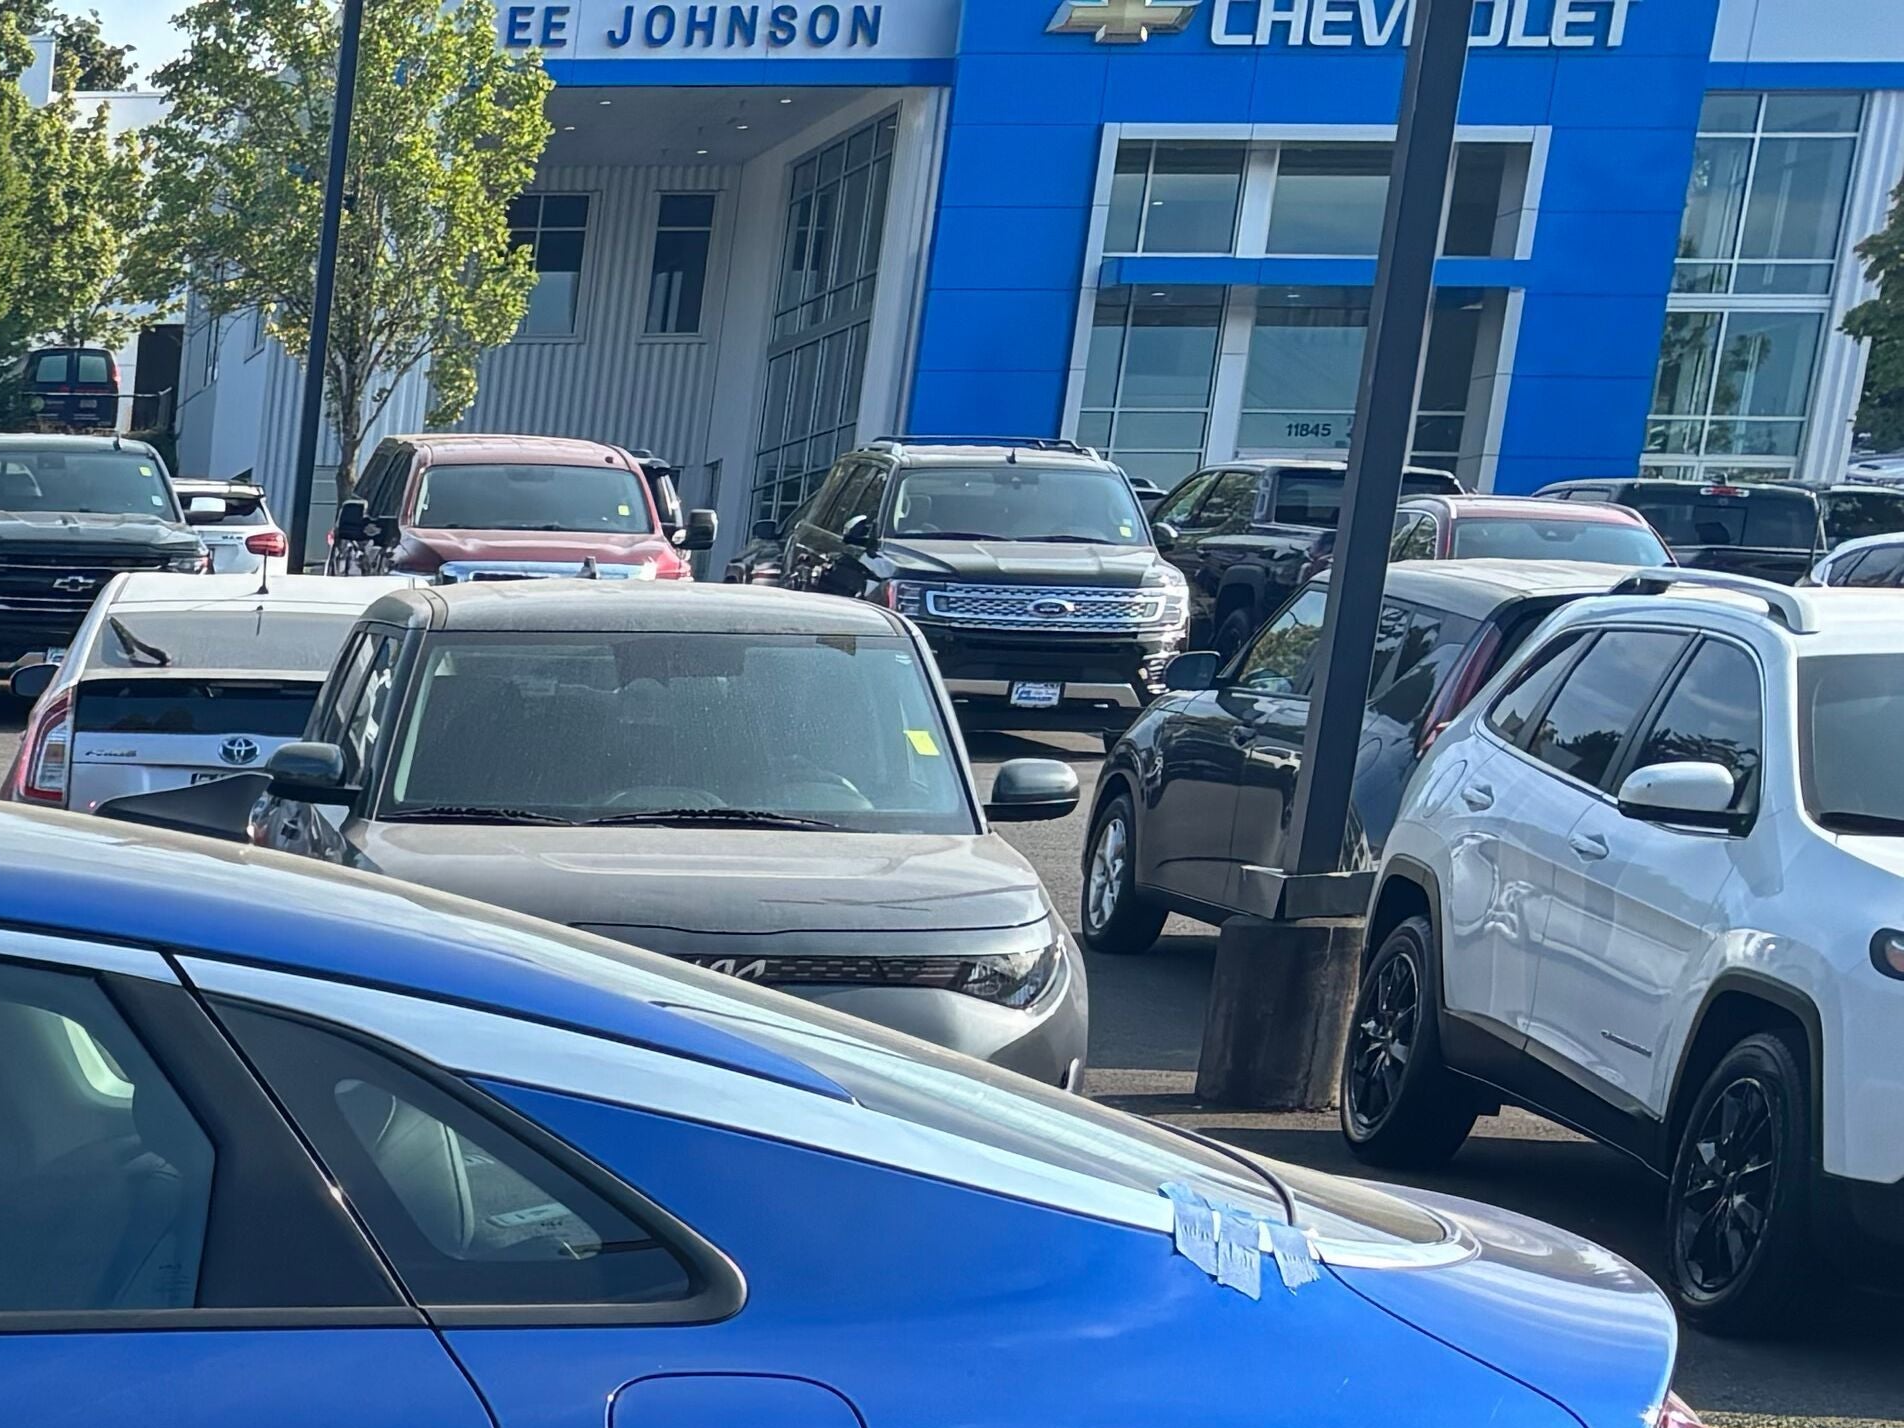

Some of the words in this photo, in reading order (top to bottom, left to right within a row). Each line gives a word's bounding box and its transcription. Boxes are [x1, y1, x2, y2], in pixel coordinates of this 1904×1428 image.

[504, 5, 569, 48] EE
[606, 4, 882, 48] JOHNSON
[1210, 0, 1626, 47] CHEVOLET
[1286, 423, 1331, 437] 11845
